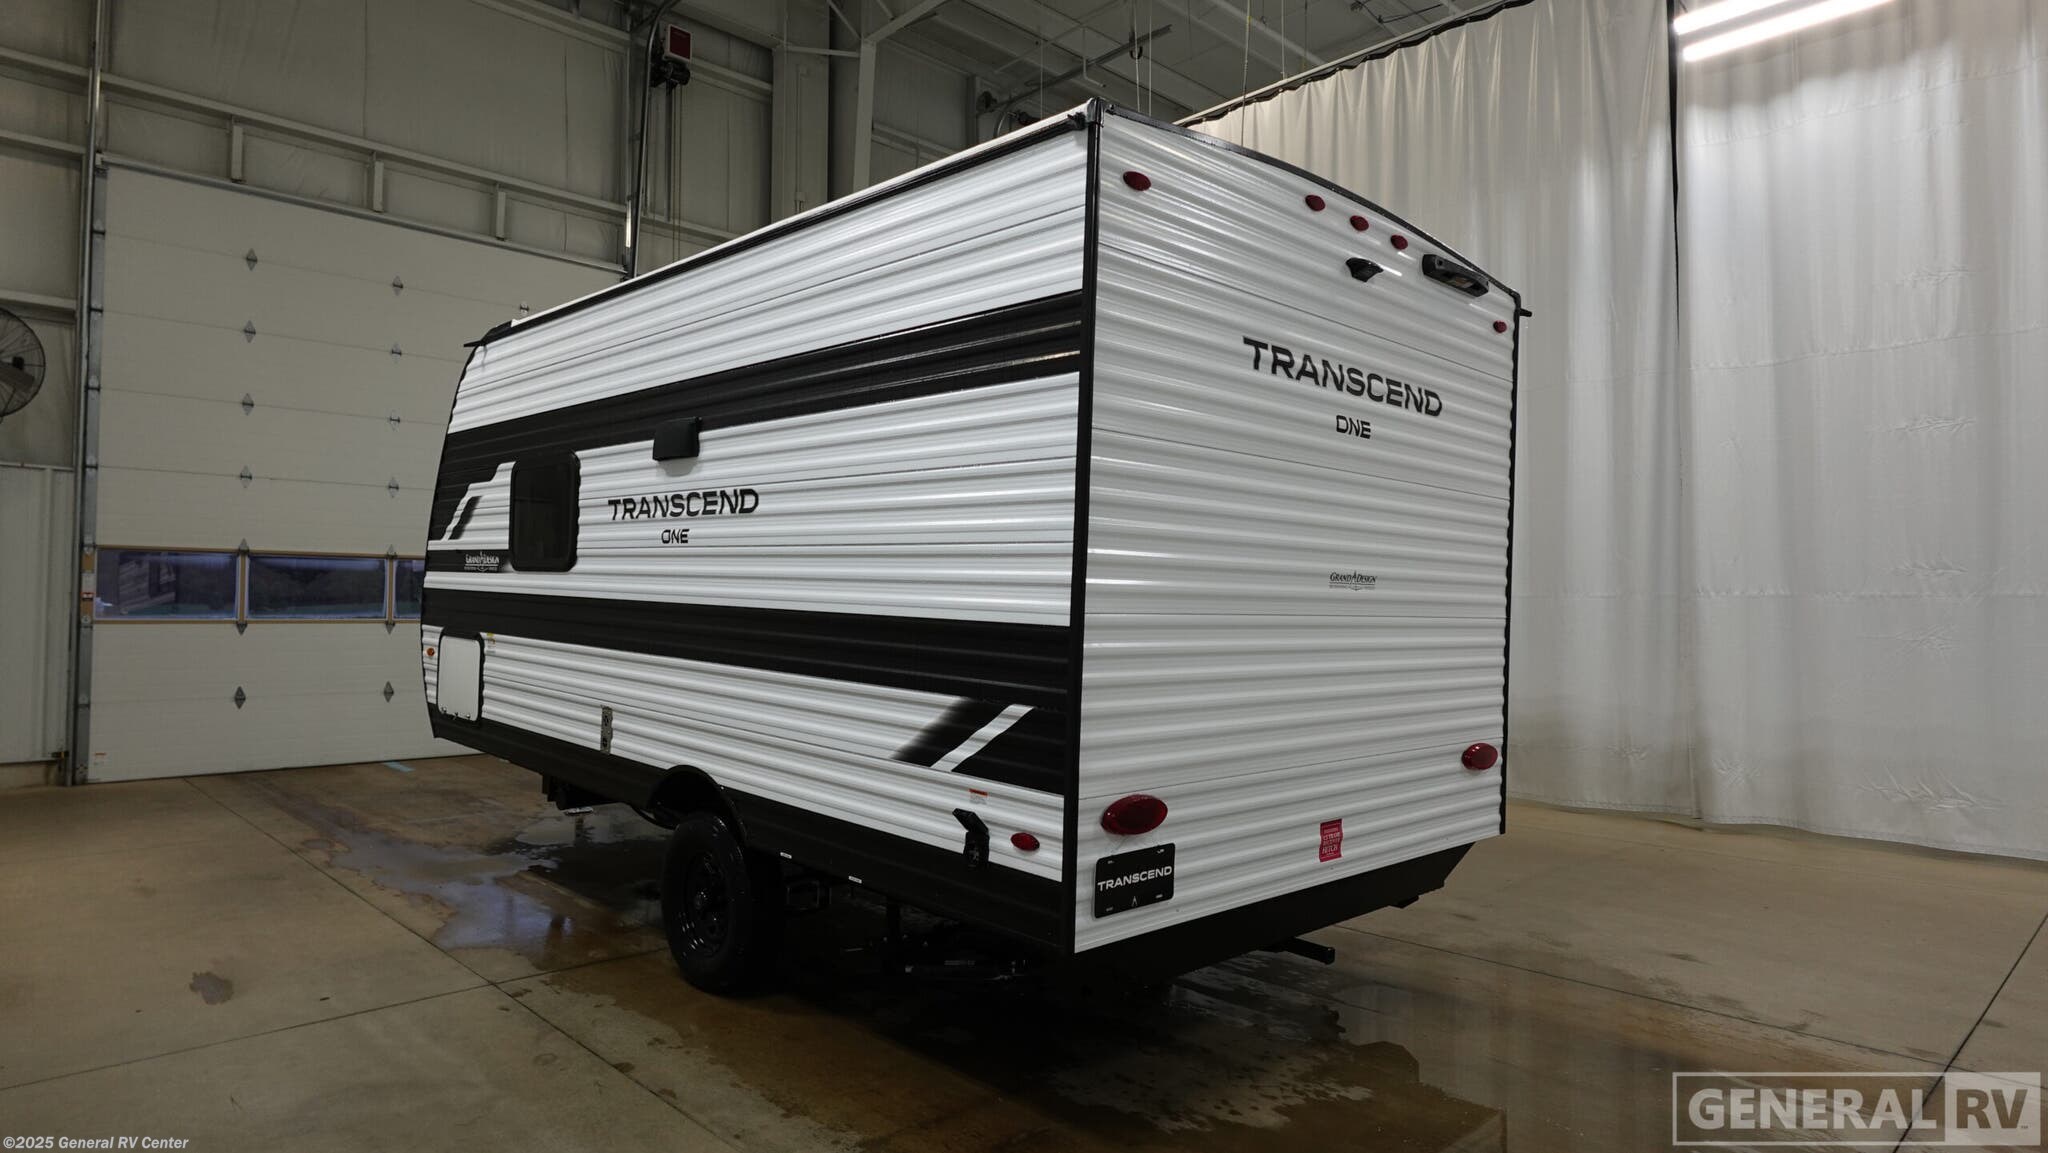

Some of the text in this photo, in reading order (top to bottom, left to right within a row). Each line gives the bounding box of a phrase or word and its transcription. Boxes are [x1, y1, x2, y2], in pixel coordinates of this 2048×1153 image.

[1243, 336, 1443, 417] TRANSCEND
[1336, 415, 1371, 439] ONE
[608, 488, 759, 520] TRANSCEND
[661, 529, 690, 544] ONE
[1097, 866, 1173, 892] TRANSCEND
